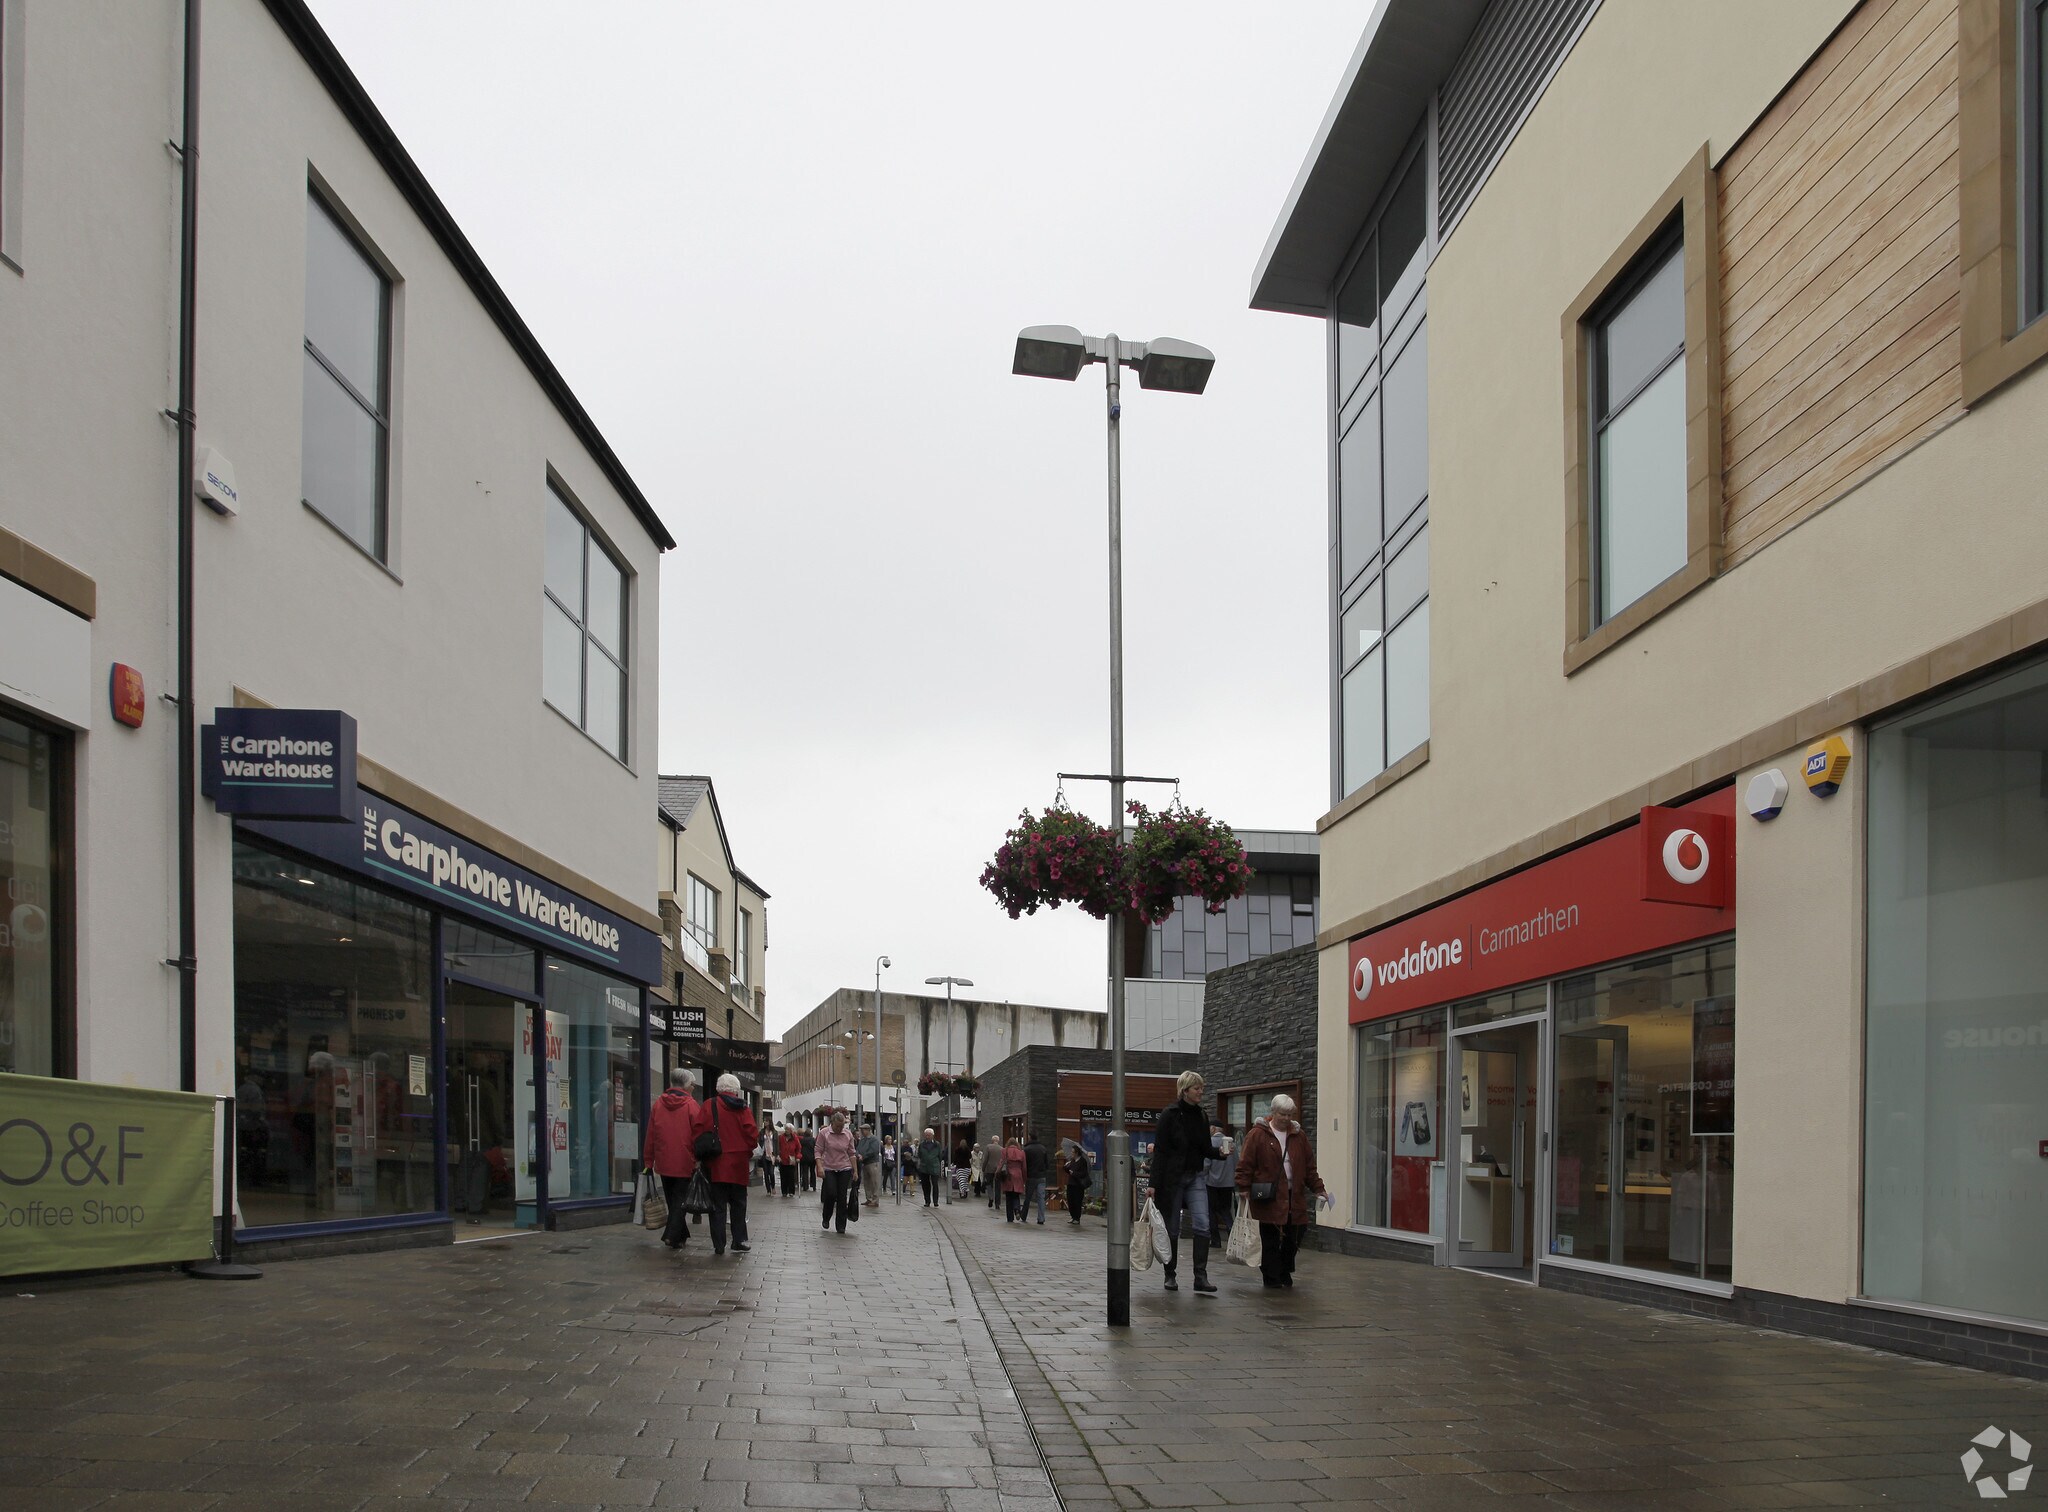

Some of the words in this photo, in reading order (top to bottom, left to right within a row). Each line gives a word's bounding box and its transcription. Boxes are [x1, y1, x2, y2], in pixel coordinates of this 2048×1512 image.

[207, 472, 237, 502] SECOM
[221, 735, 230, 755] THE
[231, 736, 334, 759] Carphone
[222, 760, 334, 779] Warehouse
[1807, 755, 1827, 773] ADT
[364, 806, 377, 852] THE
[381, 818, 512, 908] Carphone
[515, 879, 621, 951] Warehouse
[1377, 938, 1463, 987] vodafone
[1480, 904, 1579, 955] Carmarthen
[672, 1010, 704, 1022] LUSH
[672, 1020, 691, 1028] FRESH
[672, 1026, 704, 1034] HANDMADE
[672, 1031, 705, 1039] COSMETICS
[83, 1199, 145, 1229] Shop
